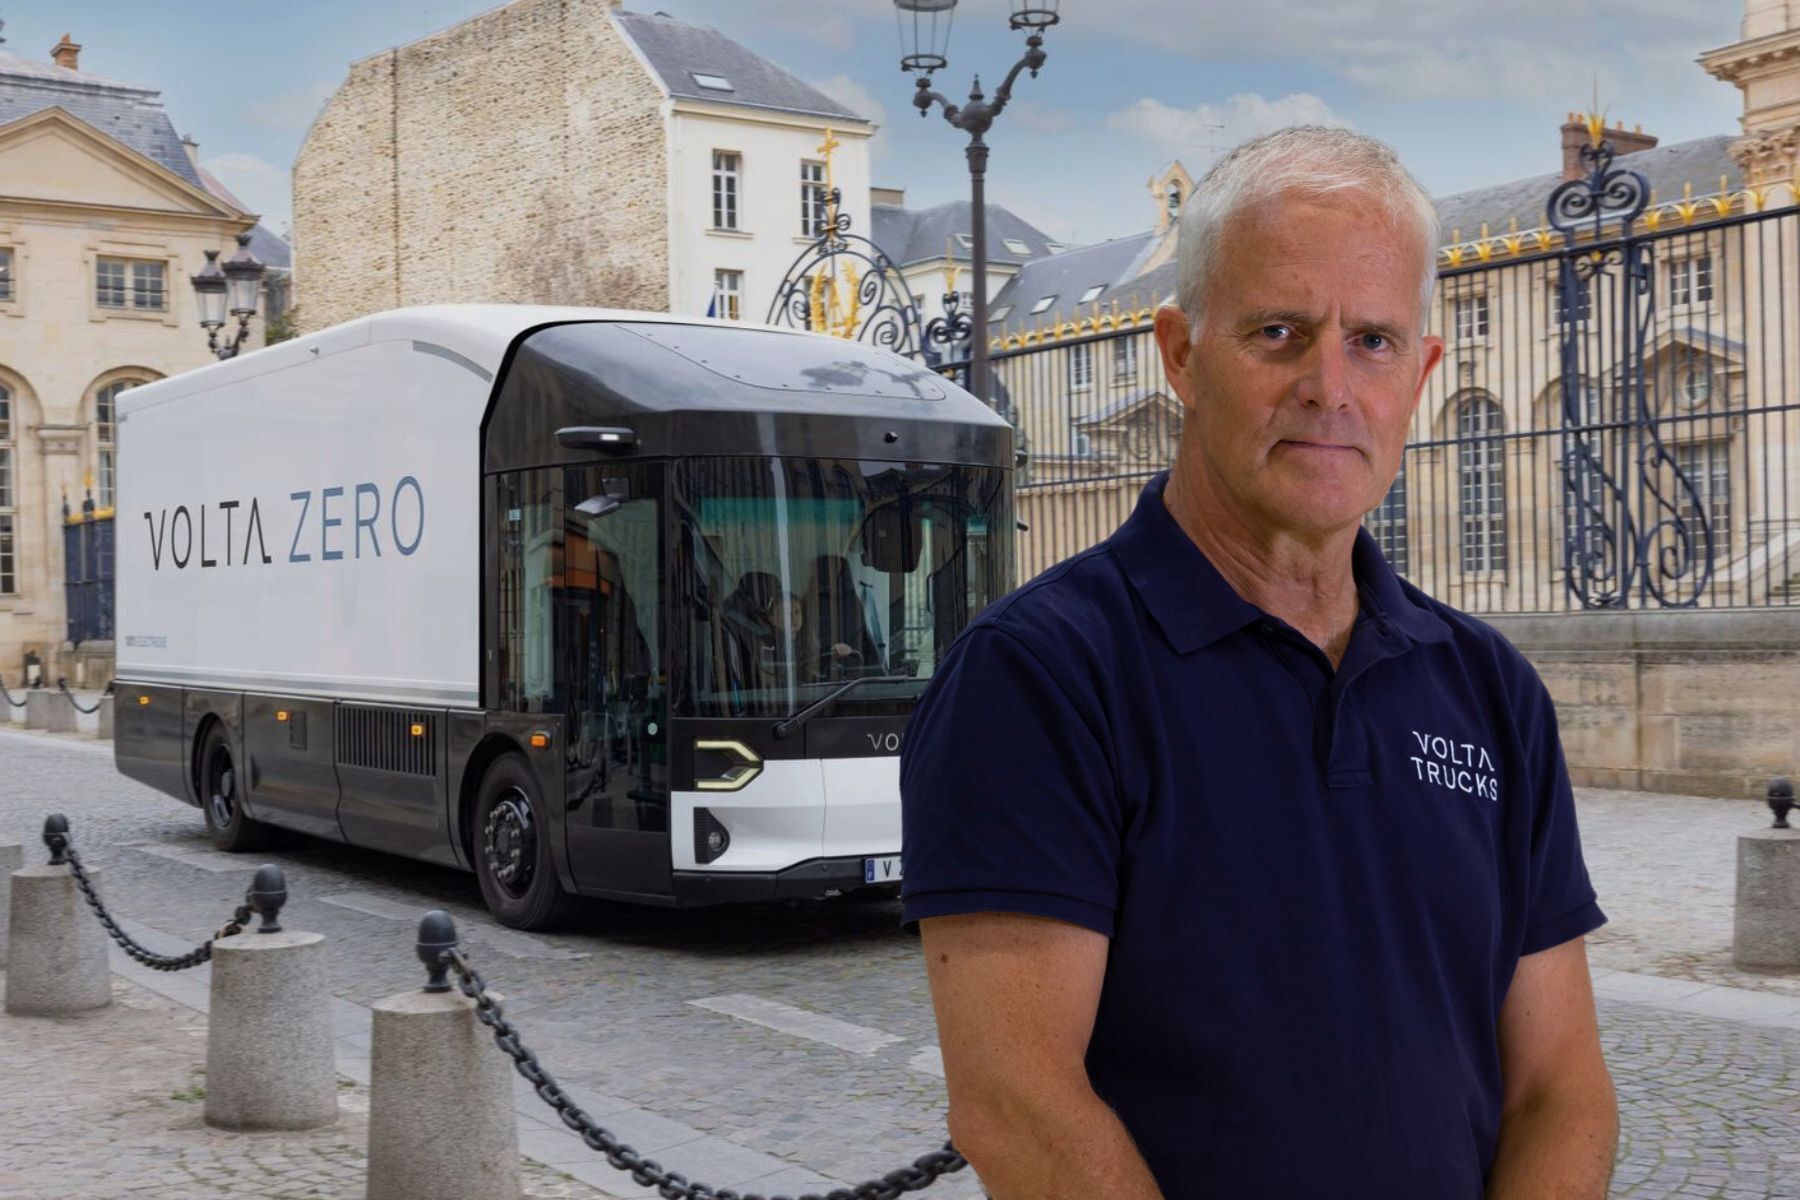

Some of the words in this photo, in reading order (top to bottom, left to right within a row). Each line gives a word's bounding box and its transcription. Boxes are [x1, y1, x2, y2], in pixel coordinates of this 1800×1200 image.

[144, 497, 272, 571] VOLTA
[289, 475, 424, 563] ZERO
[867, 733, 904, 751] VO
[1412, 731, 1495, 772] VOLTA
[1410, 757, 1498, 801] TRUCKS
